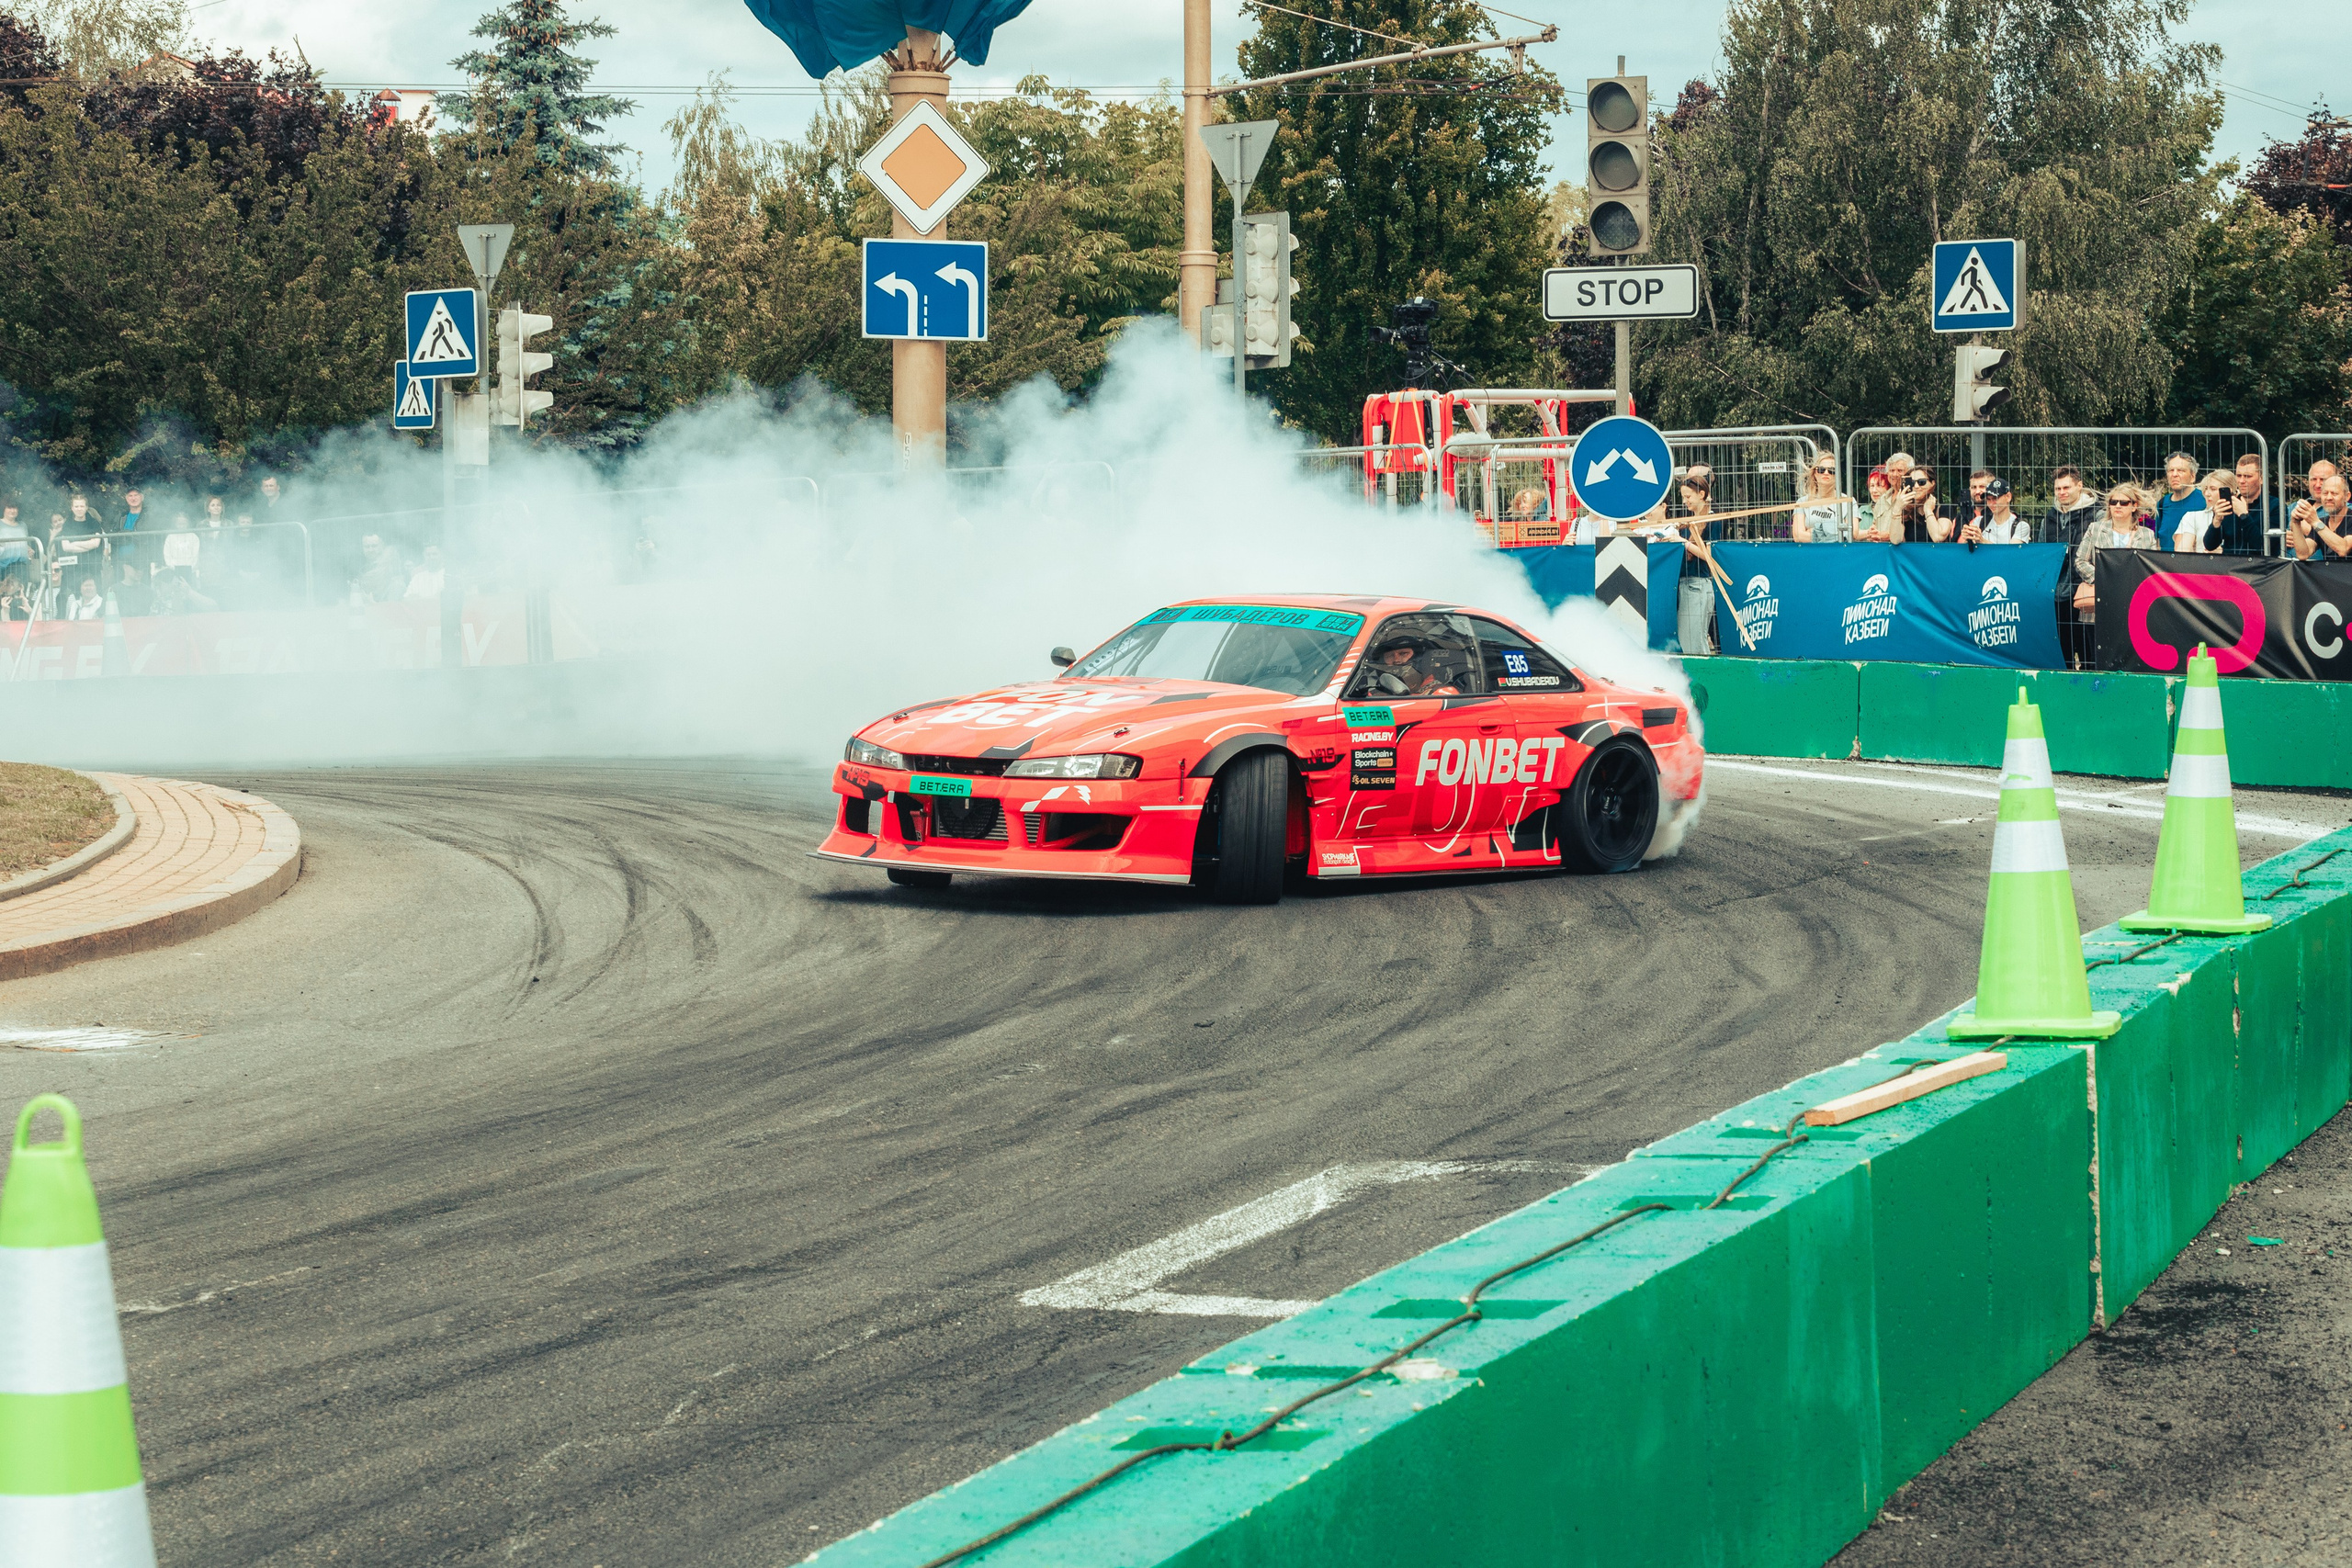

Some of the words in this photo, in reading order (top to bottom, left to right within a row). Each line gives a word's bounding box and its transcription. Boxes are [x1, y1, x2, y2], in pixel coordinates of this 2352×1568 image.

[1577, 278, 1664, 307] STOP
[1192, 608, 1309, 625] ШУБАДЁРОВ
[1841, 596, 1897, 627] ЛИМОНАД
[1968, 602, 2020, 633] ЛИМОНАД
[1845, 618, 1890, 645] КАЗБЕГИ
[1973, 626, 2017, 649] КАЗБЕГИ
[1504, 654, 1529, 672] E85
[971, 690, 1145, 706] FON
[925, 702, 1102, 728] BET
[1354, 750, 1389, 759] Blockchain
[1354, 759, 1377, 768] Sports
[1415, 737, 1565, 786] FONBET
